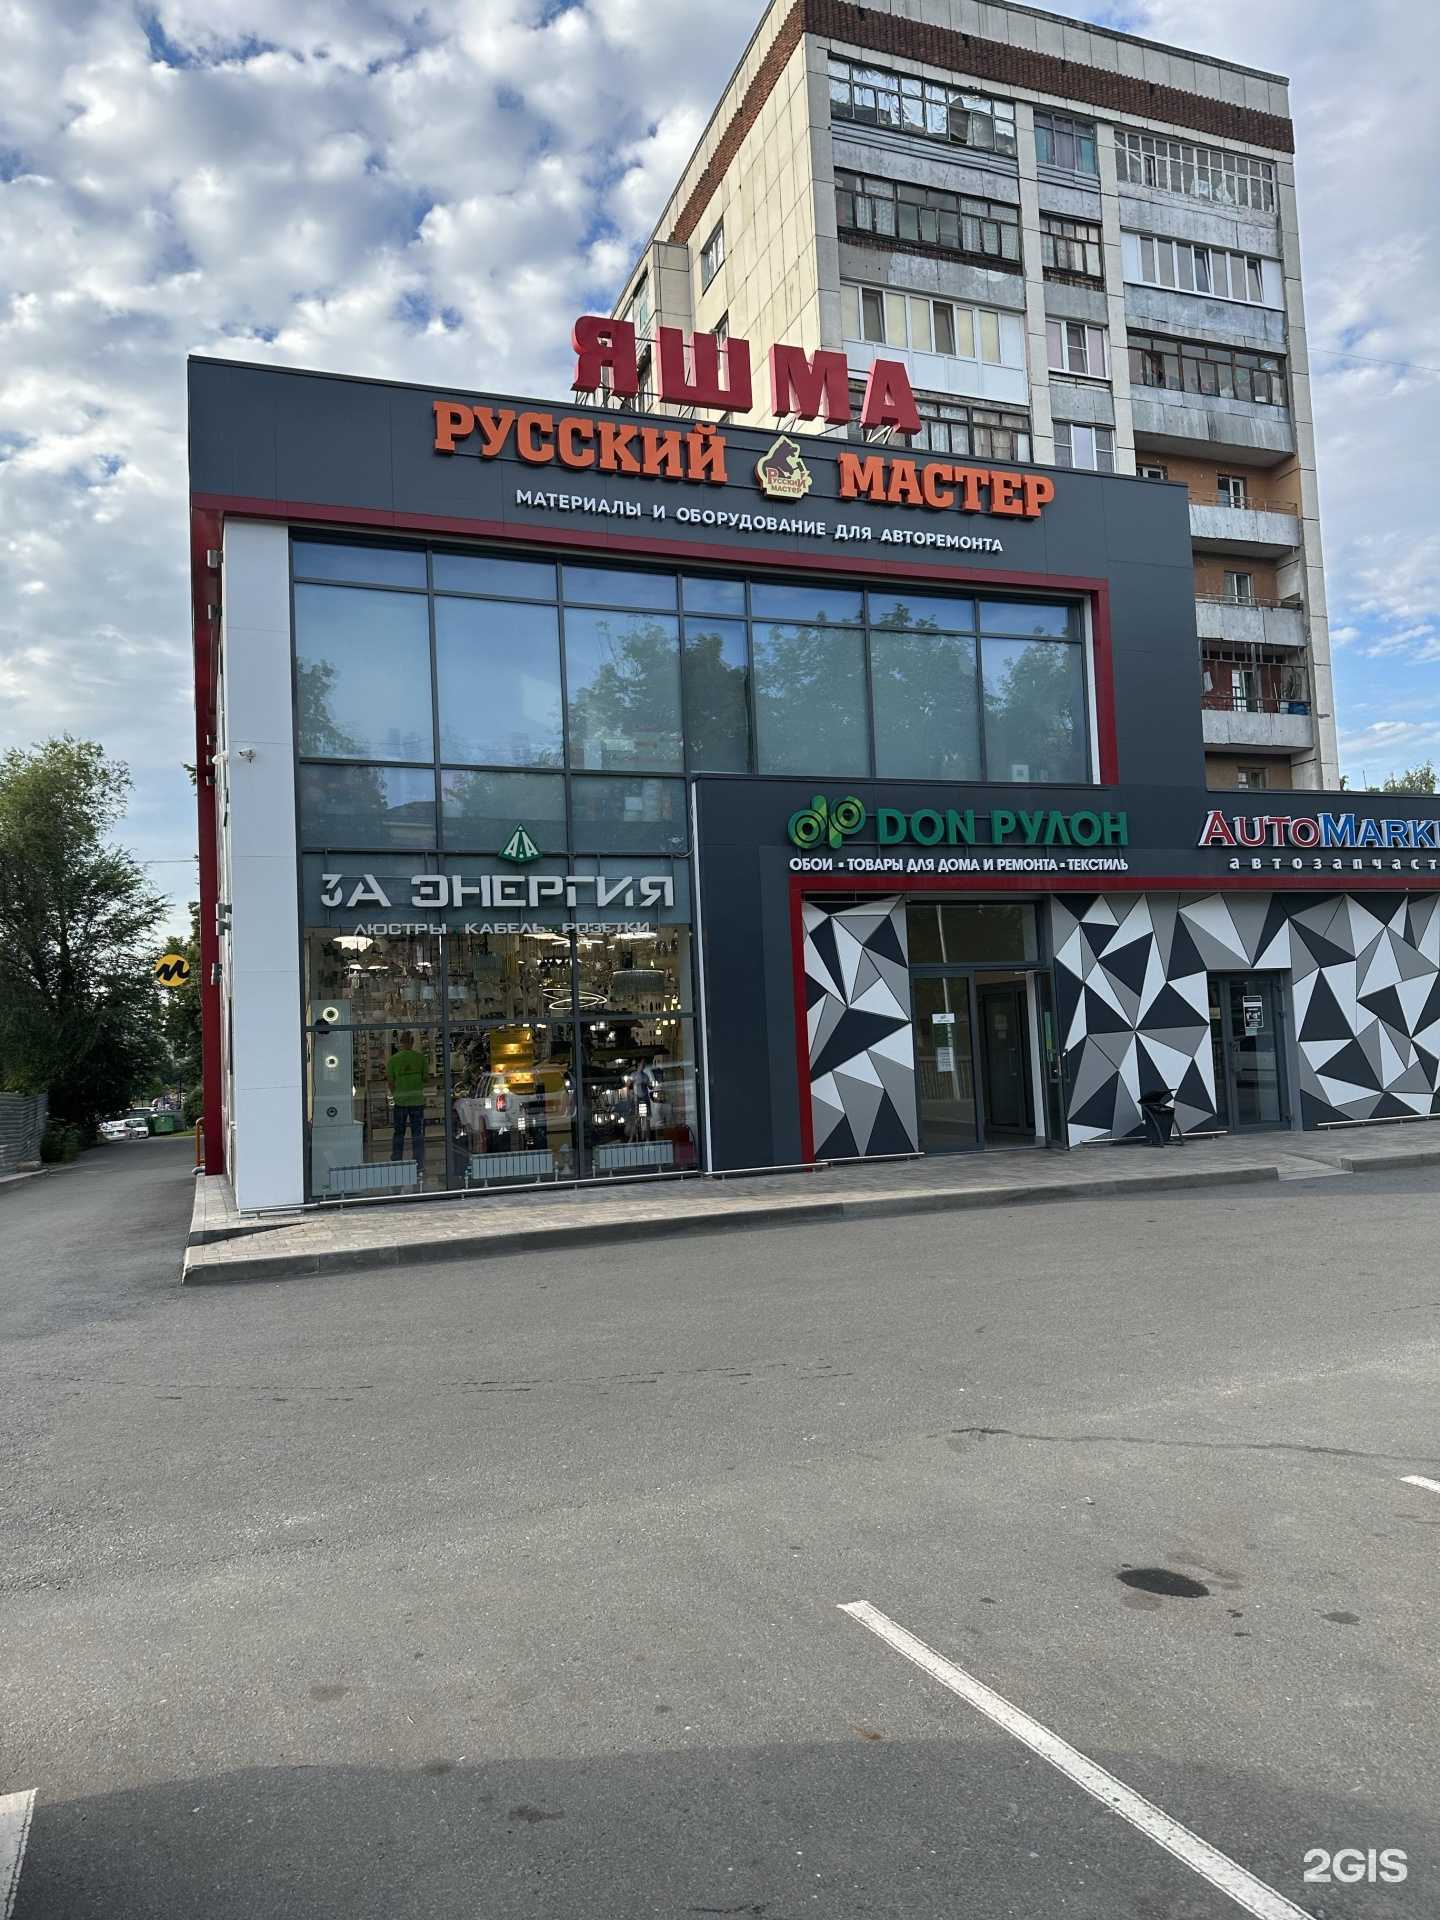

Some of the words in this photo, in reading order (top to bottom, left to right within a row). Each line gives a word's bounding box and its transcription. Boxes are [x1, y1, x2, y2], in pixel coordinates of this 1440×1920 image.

[569, 315, 923, 435] ЯШМА
[433, 401, 729, 483] РУССКИЙ
[837, 451, 1056, 518] МАСТЕР
[515, 489, 641, 517] МАТЕРИАЛЫ
[652, 505, 666, 519] И
[676, 506, 827, 537] ОБОРУДОВАНИЕ
[834, 523, 873, 541] ДЛЯ
[880, 527, 1004, 552] АВТОРЕМОНТА
[877, 807, 977, 846] DON
[990, 809, 1130, 847] РУЛОН
[788, 857, 834, 872] ОБОИ
[847, 857, 902, 872] ТОВАРЫ
[906, 857, 936, 873] ДЛЯ
[937, 857, 981, 873] ДОМА
[983, 857, 995, 872] И
[996, 857, 1058, 872] РЕМОНТА
[1066, 857, 1130, 872] ТЕКСТИЛЬ
[410, 874, 675, 908] ЭНЕРГИЯ
[354, 922, 448, 935] ЛЮСТРЫ
[464, 921, 546, 934] КАБЕЛЬ
[561, 921, 650, 934] РОЗЕТКИ
